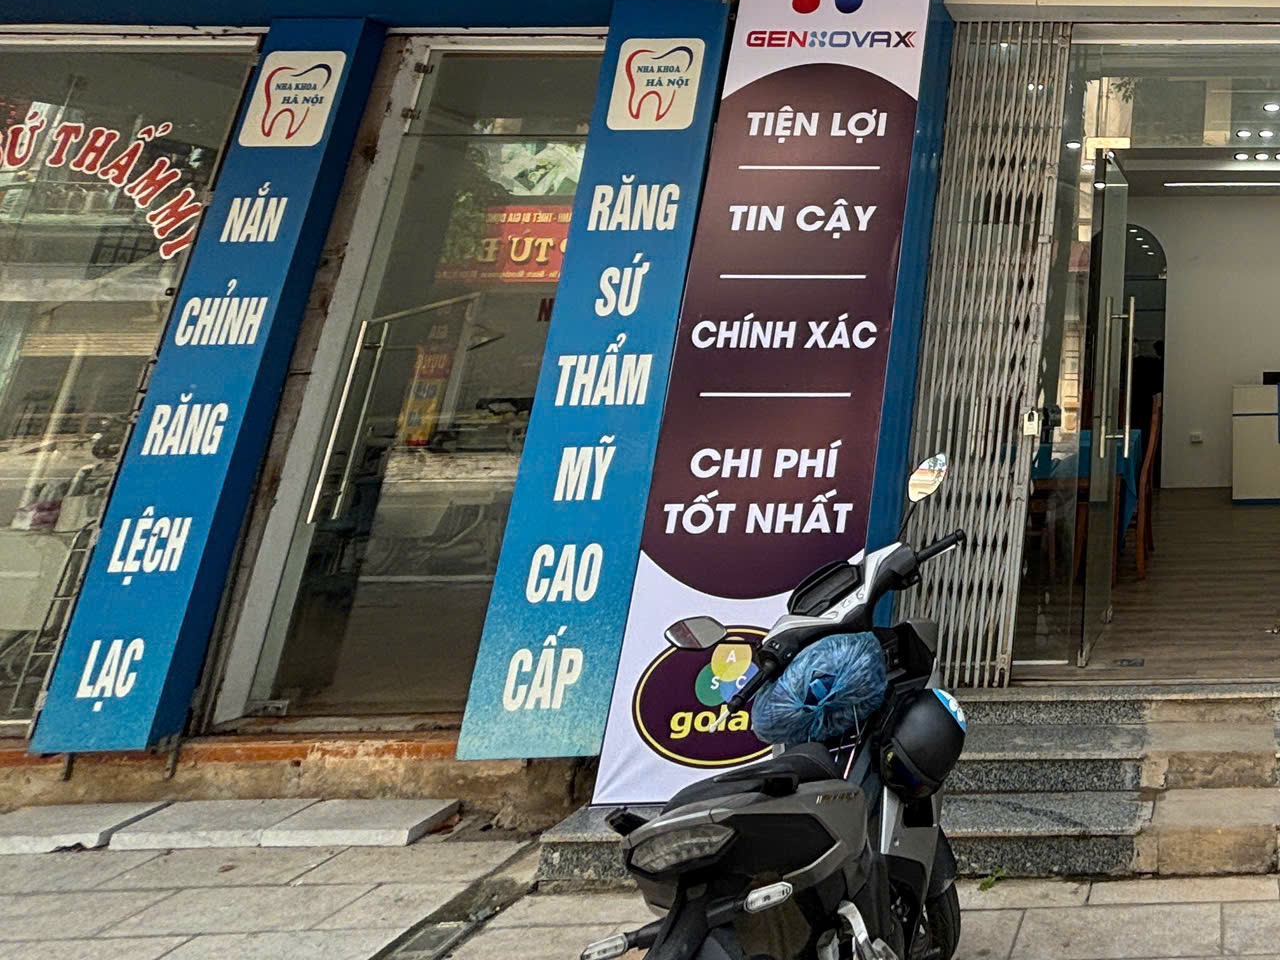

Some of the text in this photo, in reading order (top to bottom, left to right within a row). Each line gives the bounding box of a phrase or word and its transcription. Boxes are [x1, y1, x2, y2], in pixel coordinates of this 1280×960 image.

[667, 76, 690, 88] NỘI
[747, 105, 888, 143] TIỆN LỢI
[220, 182, 288, 243] NẮN
[587, 175, 680, 232] RĂNG
[729, 198, 877, 239] TIN CẬY
[175, 280, 268, 347] CHỈNH
[595, 253, 650, 317] SỨ
[691, 312, 877, 349] CHÍNH XÁC
[554, 333, 649, 406] THẨM
[140, 392, 227, 456] RĂNG
[554, 435, 616, 502] MỸ
[690, 439, 842, 478] CHI PHÍ
[663, 488, 853, 534] TỐT NHẤT
[108, 505, 192, 587] LỆCH
[526, 543, 604, 603] CAO
[76, 638, 144, 711] LẠC
[503, 626, 584, 712] CẤP
[711, 676, 720, 690] S
[726, 649, 737, 663] A
[670, 704, 750, 739] gola
